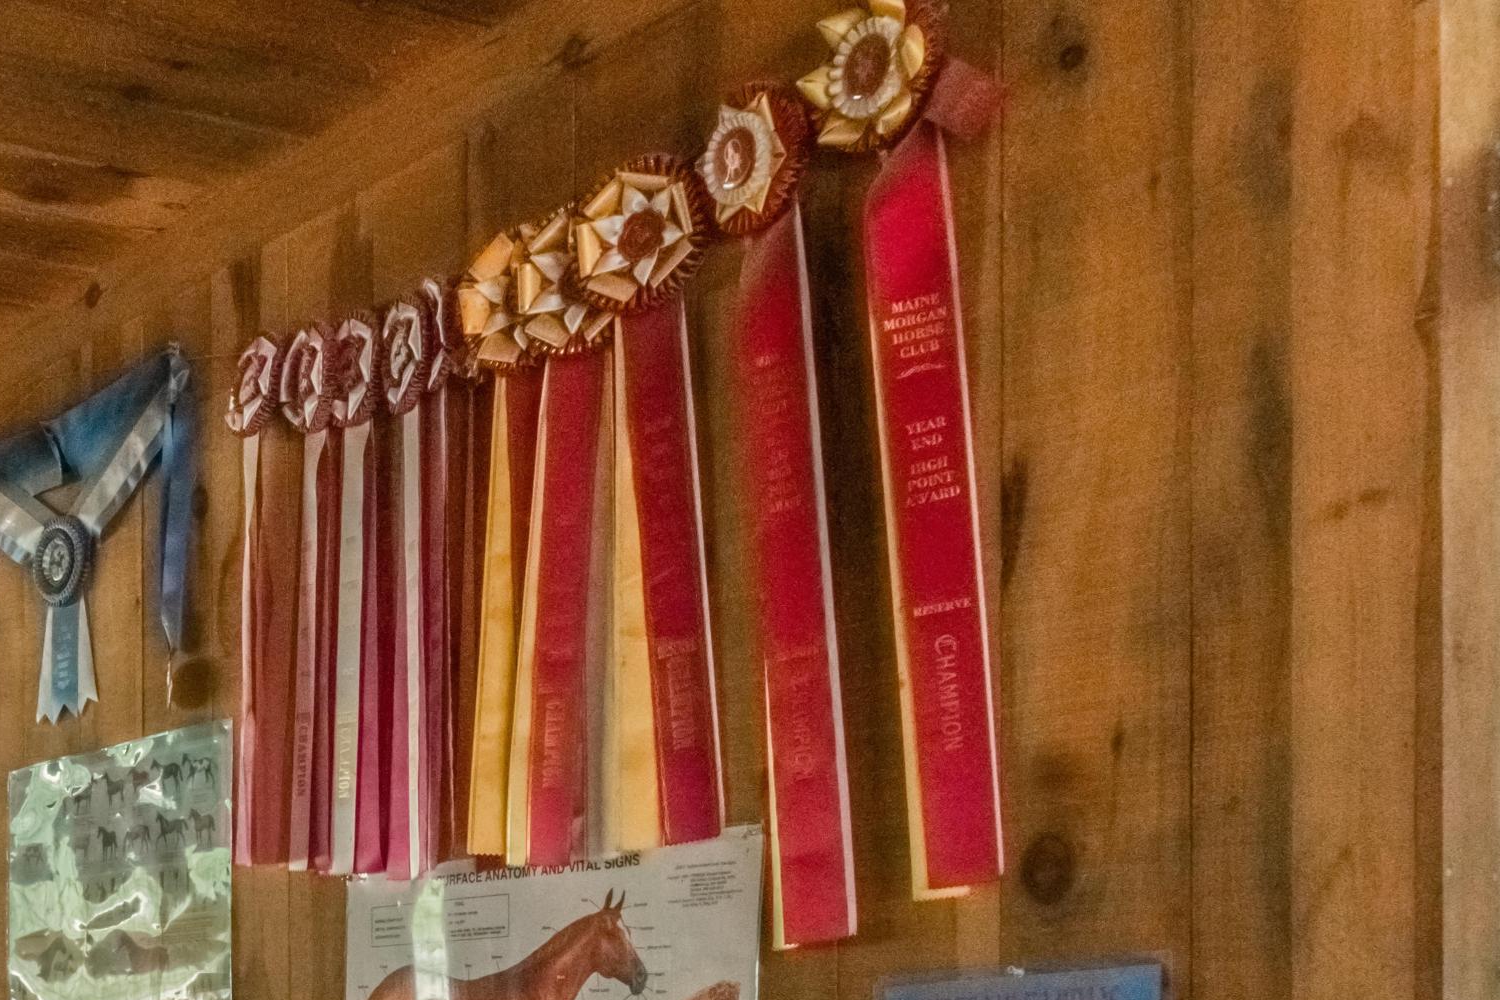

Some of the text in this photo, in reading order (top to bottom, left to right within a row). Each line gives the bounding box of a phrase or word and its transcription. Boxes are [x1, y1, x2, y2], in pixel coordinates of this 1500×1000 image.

[891, 293, 940, 314] MAINE
[883, 305, 947, 332] MORGAN
[892, 321, 946, 346] HORSE
[900, 340, 940, 358] CLUB
[905, 416, 946, 436] YEAR
[911, 434, 942, 450] END
[911, 455, 948, 476] HIGH
[908, 470, 954, 491] POINT
[907, 485, 960, 507] AWARD
[913, 598, 972, 617] RESERVE
[934, 634, 964, 752] CHAMPION
[297, 721, 309, 796] CHAMPION
[485, 867, 537, 882] ANATOMY
[541, 863, 565, 876] AND
[568, 859, 601, 873] VITAL
[604, 854, 641, 870] SIGNS
